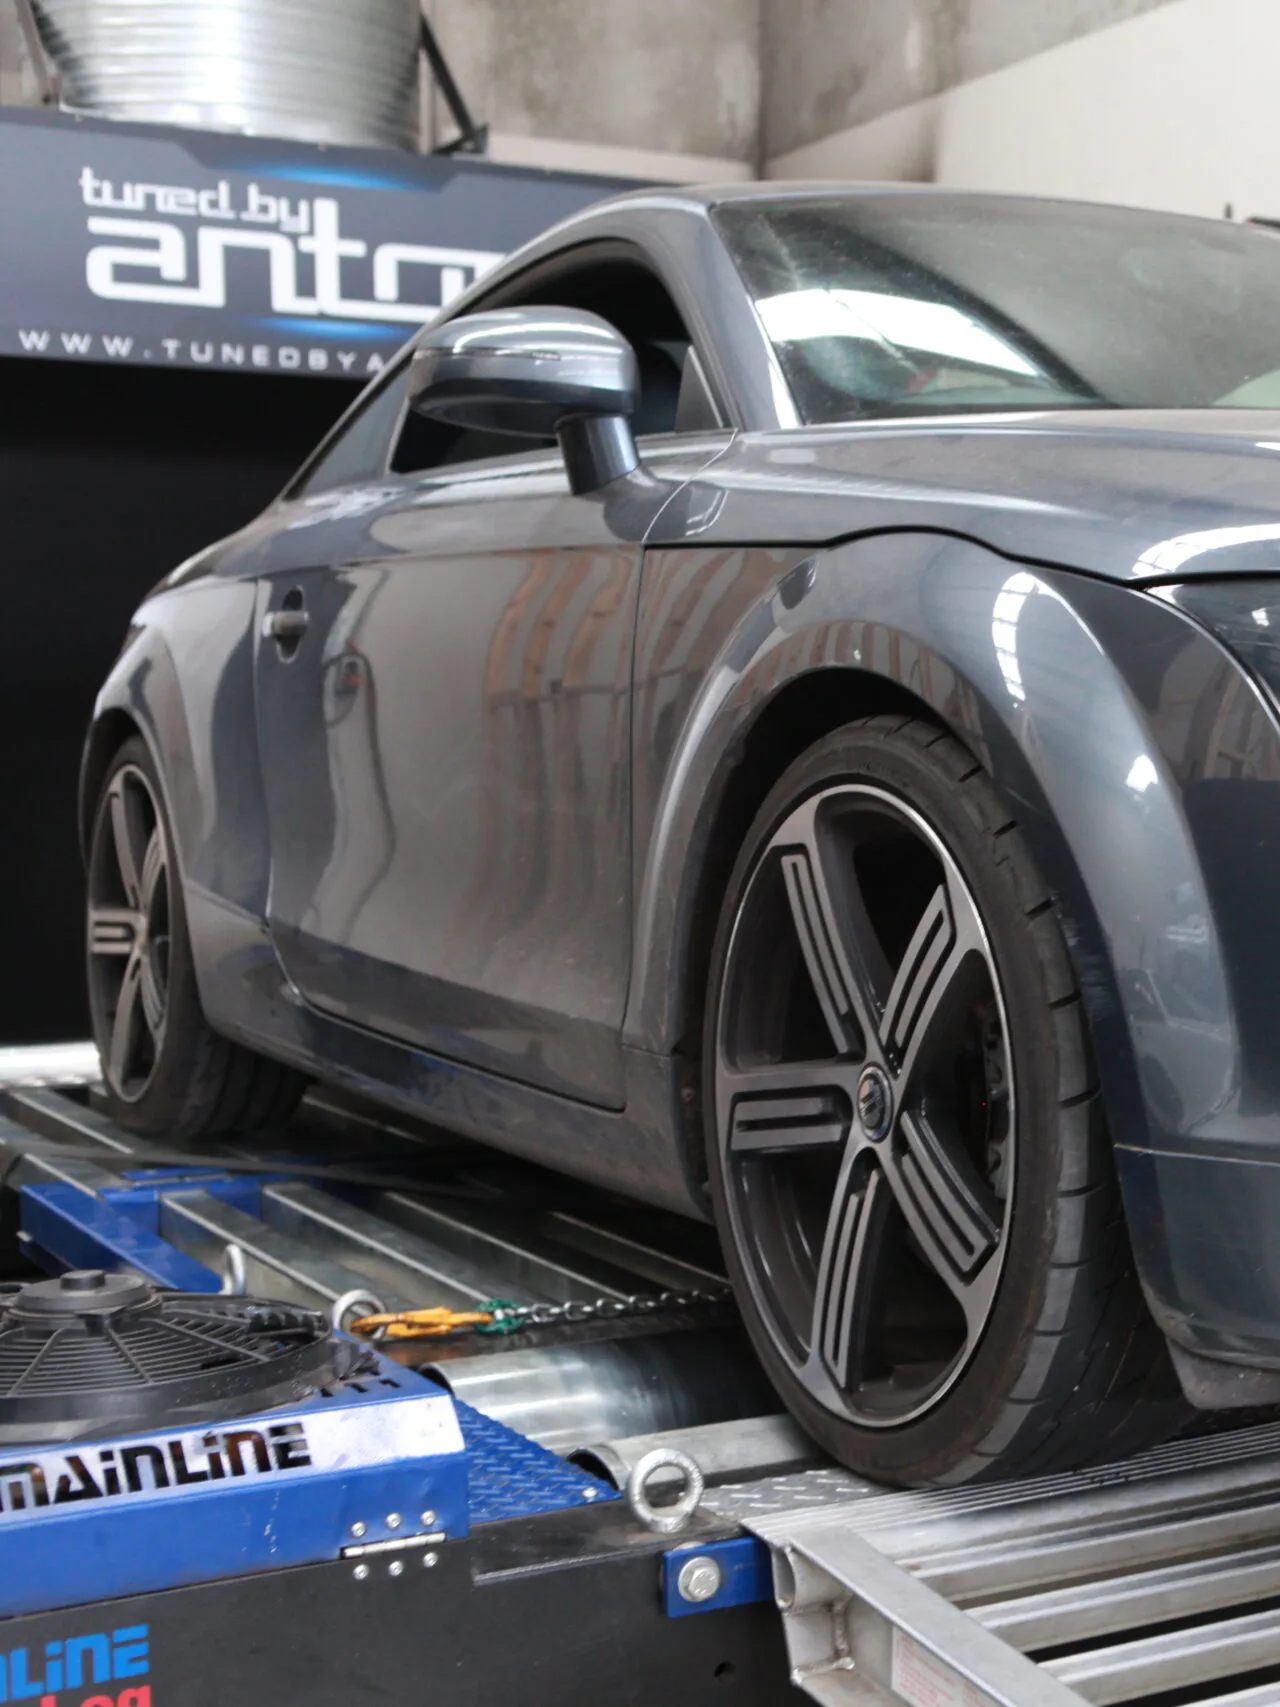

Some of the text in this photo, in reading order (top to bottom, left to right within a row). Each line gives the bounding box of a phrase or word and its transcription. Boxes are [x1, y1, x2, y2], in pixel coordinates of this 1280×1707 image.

[78, 167, 310, 232] tuned by
[86, 197, 507, 323] anto
